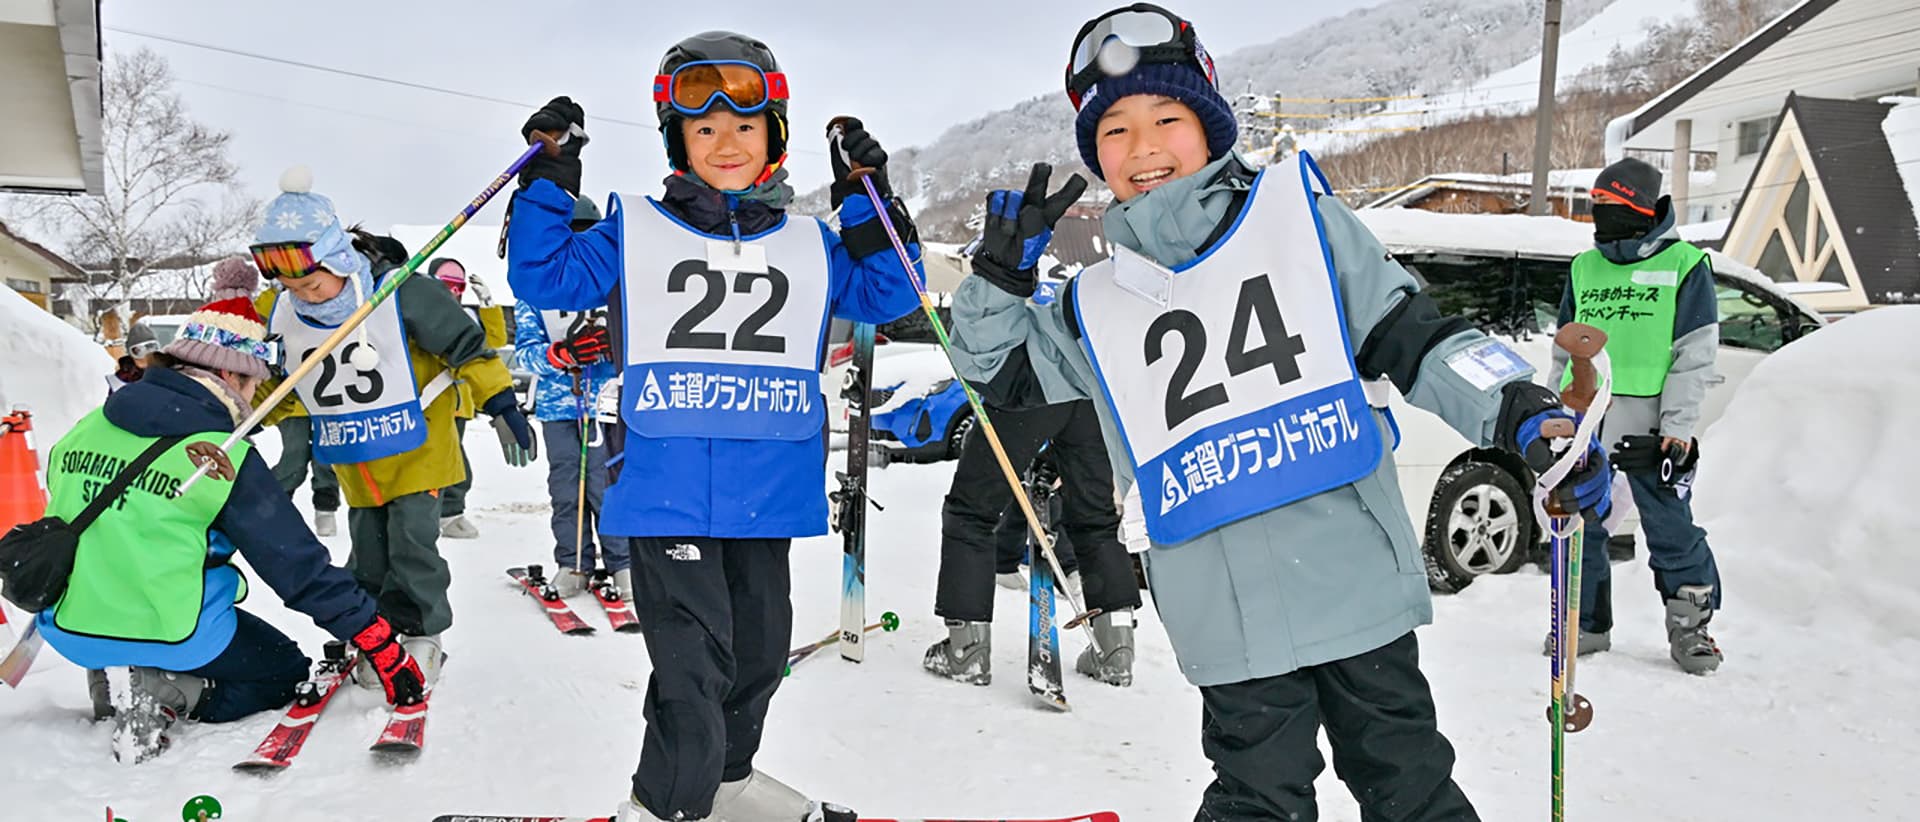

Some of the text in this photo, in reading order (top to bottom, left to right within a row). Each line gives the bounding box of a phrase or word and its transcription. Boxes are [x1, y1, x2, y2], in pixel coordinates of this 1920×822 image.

[666, 259, 789, 354] 22
[1580, 286, 1660, 304] そらまめキッズ
[301, 341, 385, 408] 23
[1144, 273, 1306, 431] 24
[668, 372, 811, 413] 志賀グランドホテル
[1180, 398, 1359, 497] 志賀グランドホテル
[136, 468, 181, 500] KIDS
[842, 630, 859, 644] 50
[1039, 586, 1052, 663] PARABOLIC
